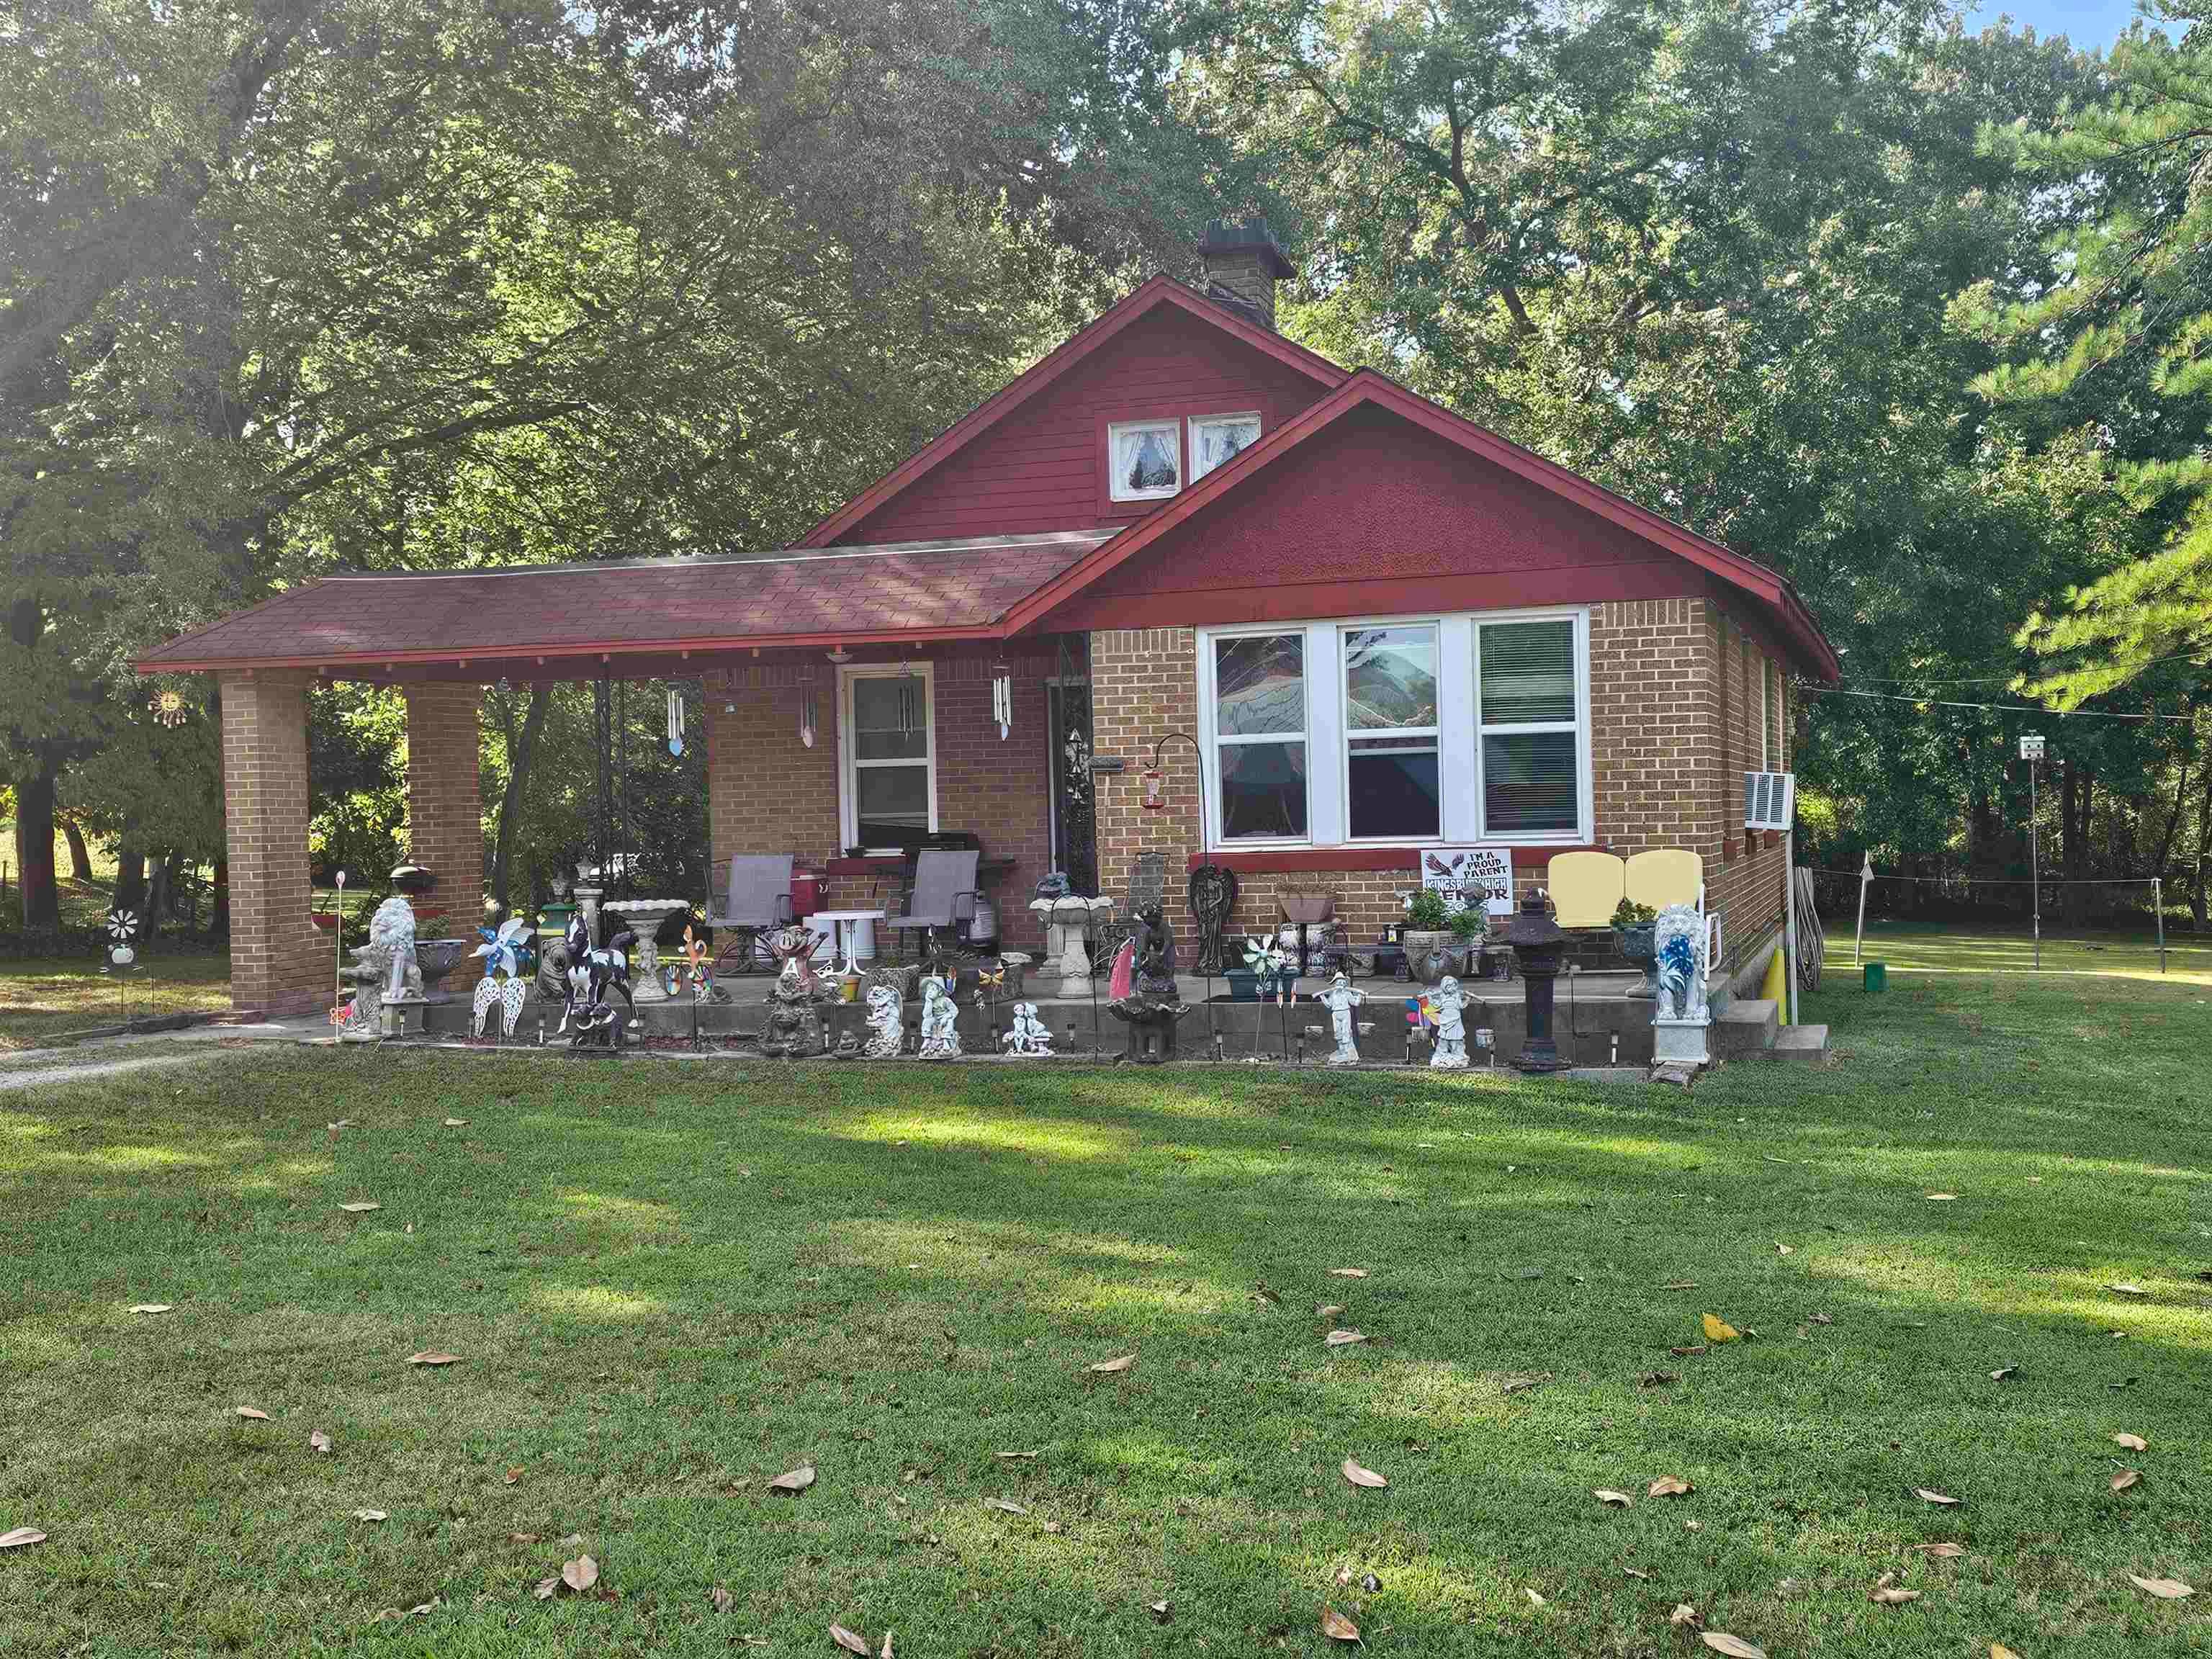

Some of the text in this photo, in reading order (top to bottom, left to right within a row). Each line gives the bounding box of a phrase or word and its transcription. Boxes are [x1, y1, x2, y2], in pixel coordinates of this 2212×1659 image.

[1470, 853, 1483, 861] I'M
[1466, 858, 1501, 871] PROUD
[1463, 865, 1508, 878] PARENT
[1485, 878, 1508, 890] HIGH
